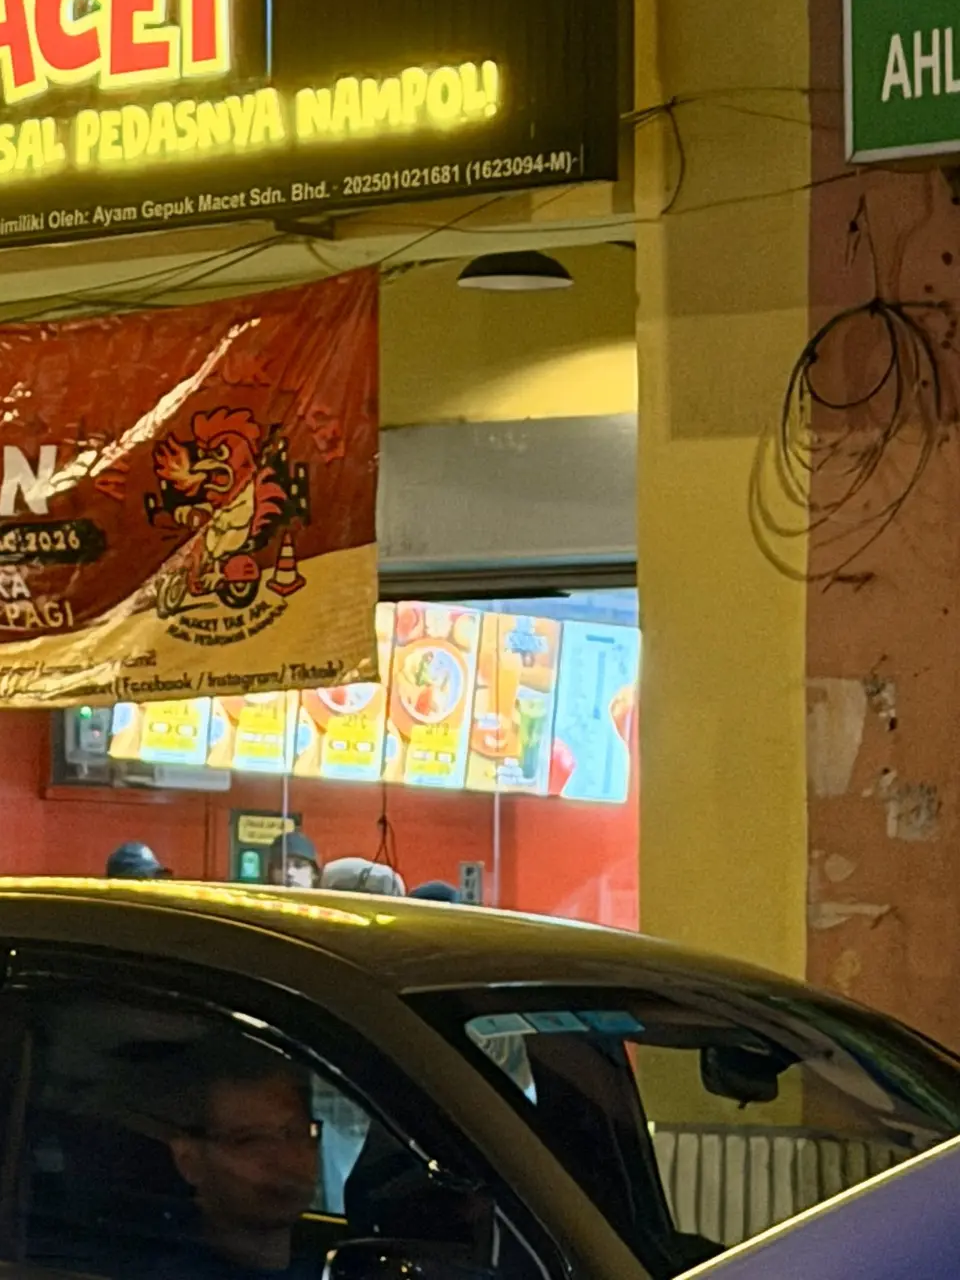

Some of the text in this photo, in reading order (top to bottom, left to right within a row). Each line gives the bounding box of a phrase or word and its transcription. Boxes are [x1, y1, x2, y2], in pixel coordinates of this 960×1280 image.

[76, 87, 286, 168] PEDASNYA
[295, 60, 499, 140] NAMPOL!
[49, 209, 90, 229] Oleh:
[93, 204, 137, 227] Ayam
[141, 197, 194, 220] Gepuk
[198, 191, 246, 213] Macet
[250, 187, 286, 207] Sdn.
[291, 181, 330, 202] Bhd.
[343, 164, 461, 195] 202501021681
[466, 151, 572, 186] (1623094-M)
[25, 530, 80, 552] 2026
[5, 600, 75, 629] PAGI
